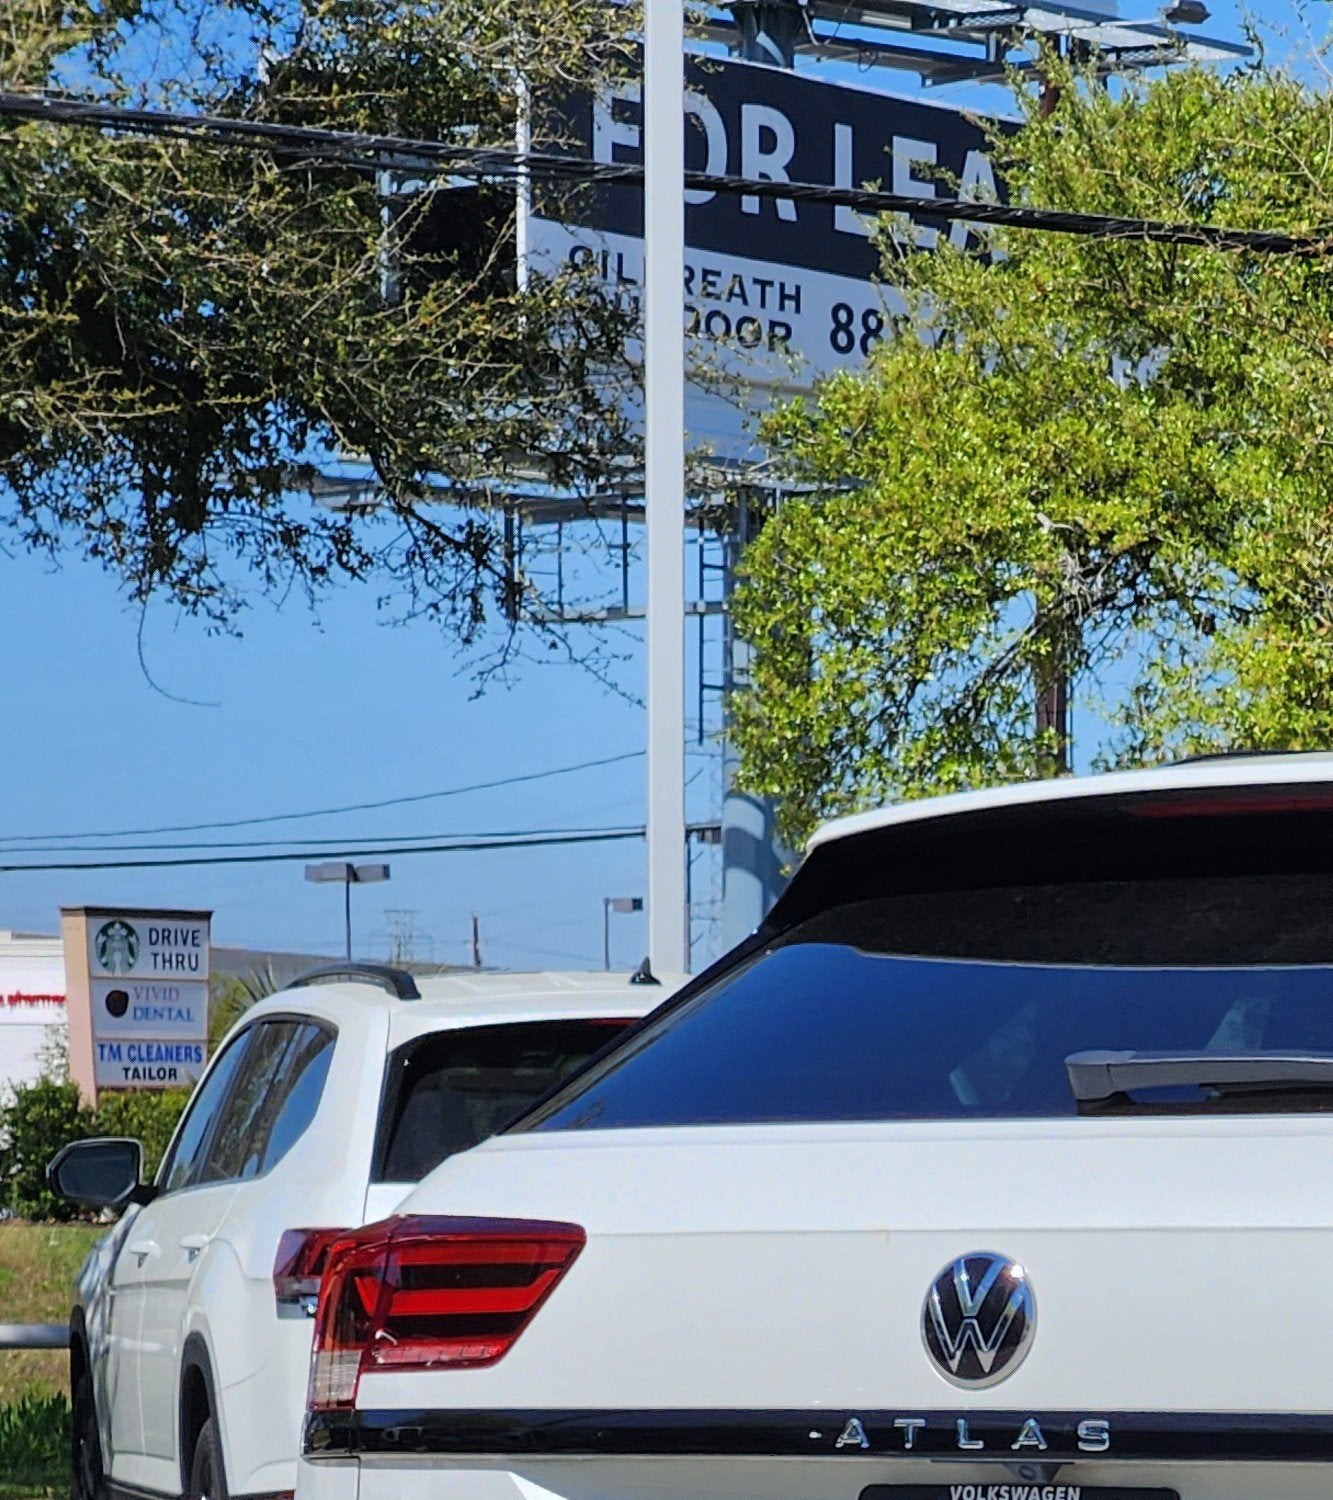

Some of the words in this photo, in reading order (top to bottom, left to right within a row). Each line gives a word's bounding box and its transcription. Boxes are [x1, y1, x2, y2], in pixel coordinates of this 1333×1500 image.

[593, 76, 798, 222] FOR
[834, 122, 1009, 263] LEA
[148, 927, 201, 948] DRIVE
[150, 951, 199, 972] THRU
[133, 986, 181, 1001] VIVID
[133, 1006, 195, 1023] DENTAL
[98, 1043, 123, 1063] TM
[128, 1044, 203, 1063] CLEANERS
[122, 1066, 178, 1082] TAILOR
[834, 1417, 1112, 1453] ATLAS
